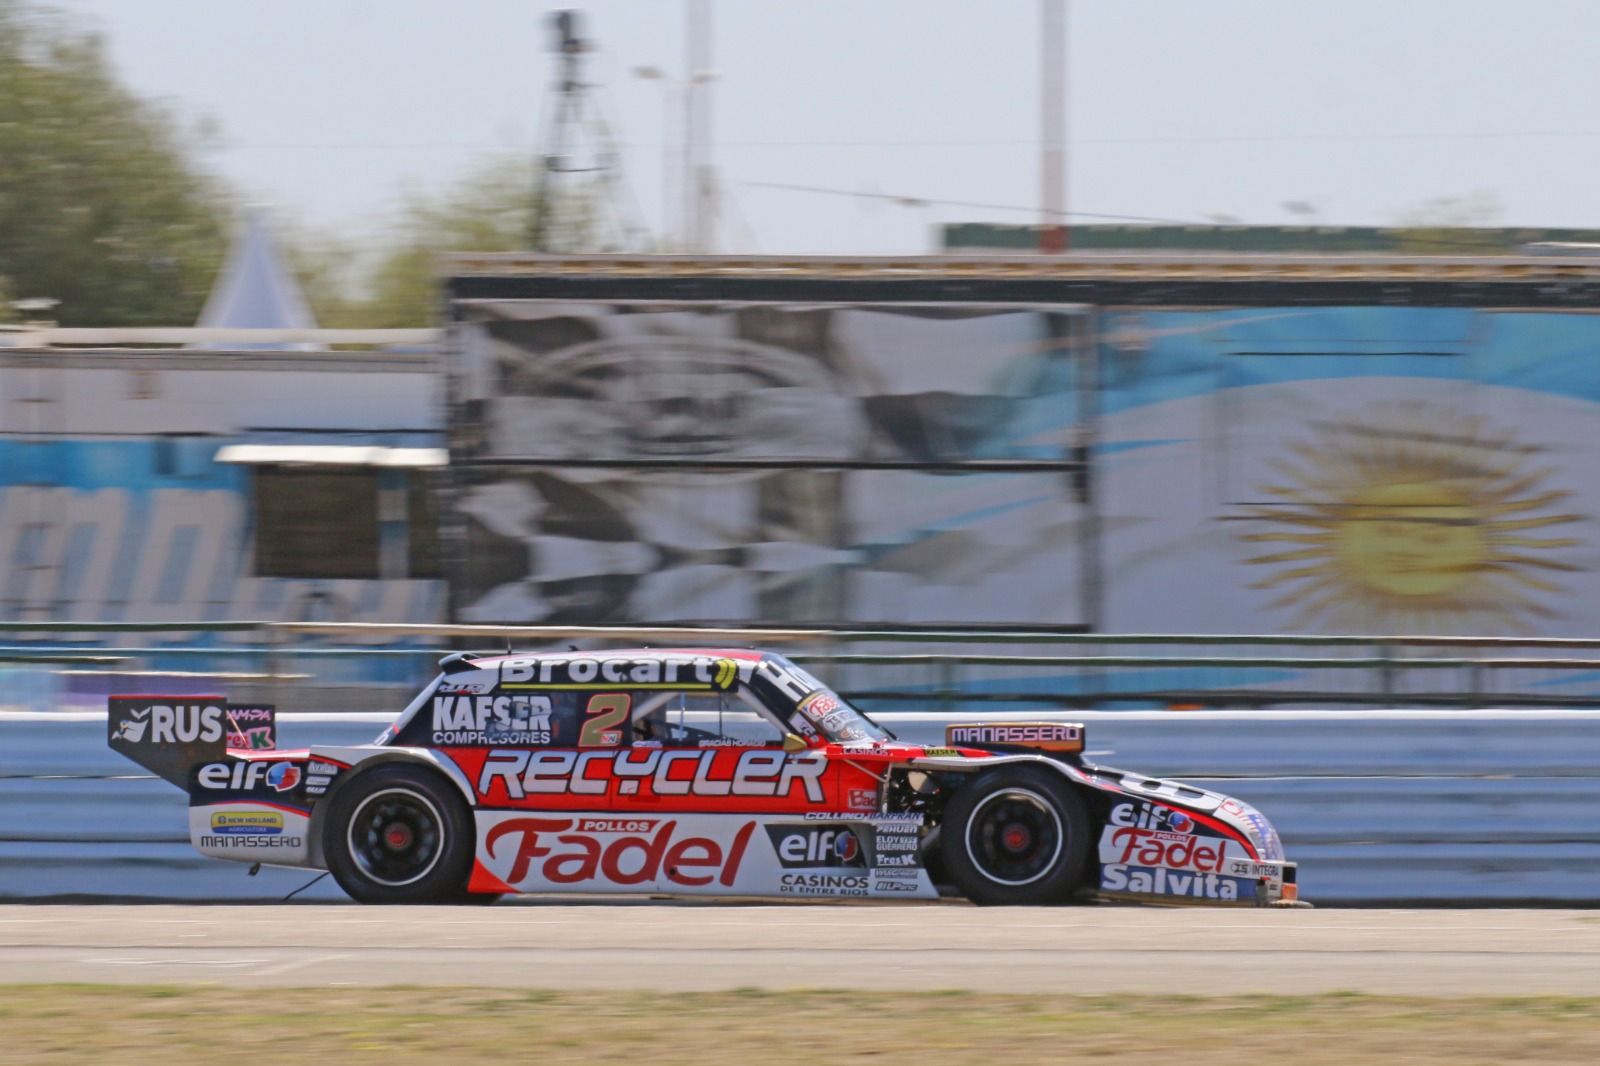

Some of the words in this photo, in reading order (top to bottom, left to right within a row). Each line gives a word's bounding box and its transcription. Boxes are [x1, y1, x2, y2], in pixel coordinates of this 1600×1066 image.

[501, 658, 713, 683] Brocart
[152, 705, 223, 743] RUS
[432, 696, 552, 731] KAESER
[578, 692, 632, 748] 2
[432, 731, 551, 745] COMPRESORES
[951, 727, 1080, 742] MANASSERO
[197, 761, 268, 790] elf
[583, 820, 651, 832] POLLOS
[1111, 802, 1169, 829] elf
[200, 835, 301, 848] MANASSERO
[779, 831, 835, 862] elf
[876, 835, 900, 844] ELOY
[1156, 832, 1188, 842] POLLOS
[485, 817, 757, 887] Fadel
[1112, 827, 1227, 873] Fadel
[781, 874, 869, 889] CASINOS
[1101, 864, 1238, 901] Salvita
[1251, 865, 1279, 876] INTEGRA
[780, 885, 794, 893] DE
[799, 886, 836, 895] ENTRE
[840, 888, 869, 896] RIOS
